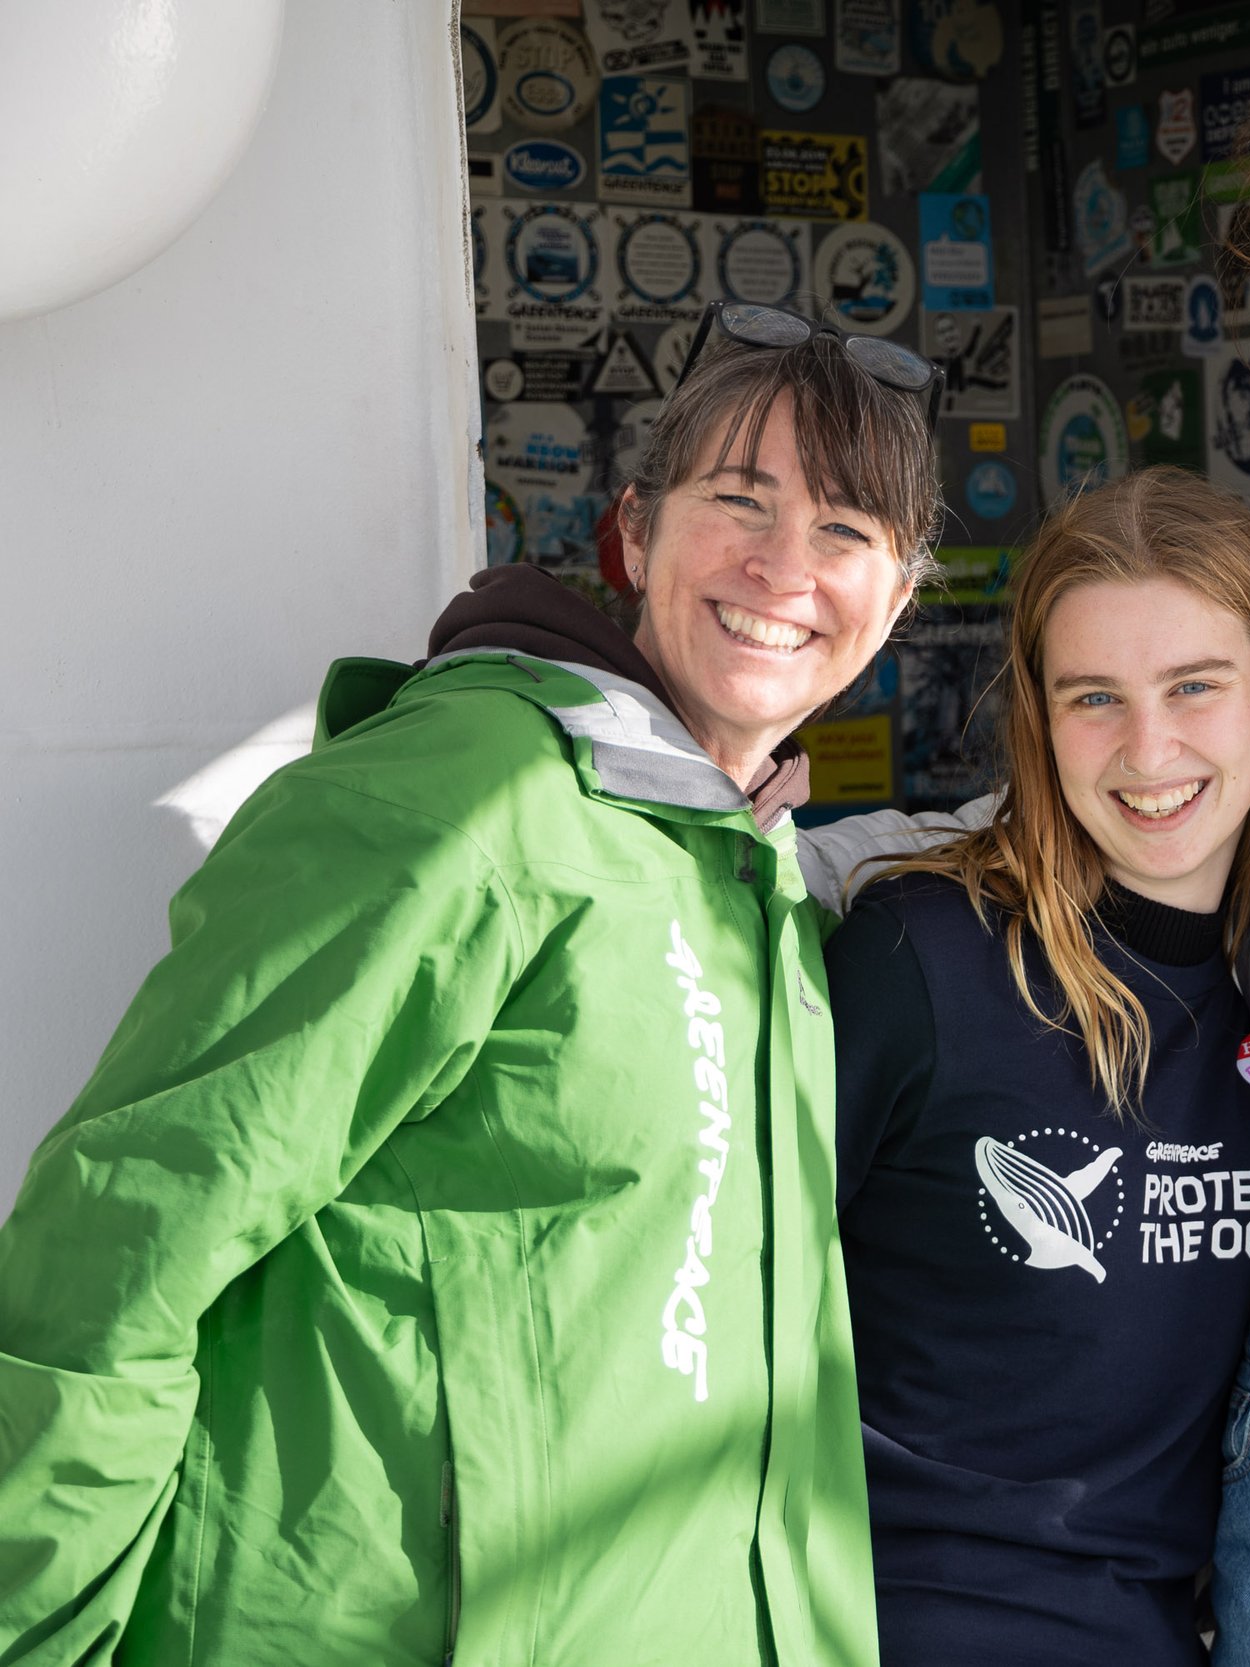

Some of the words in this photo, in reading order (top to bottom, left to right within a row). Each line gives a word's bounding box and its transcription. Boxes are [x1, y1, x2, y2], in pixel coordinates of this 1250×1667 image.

[604, 177, 684, 196] GREENPEACE
[767, 172, 821, 193] STOP
[508, 304, 602, 321] GREENPEACE
[661, 918, 732, 1403] GREENPEACE
[1145, 1141, 1224, 1164] GREENPEACE
[1139, 1221, 1205, 1263] THE
